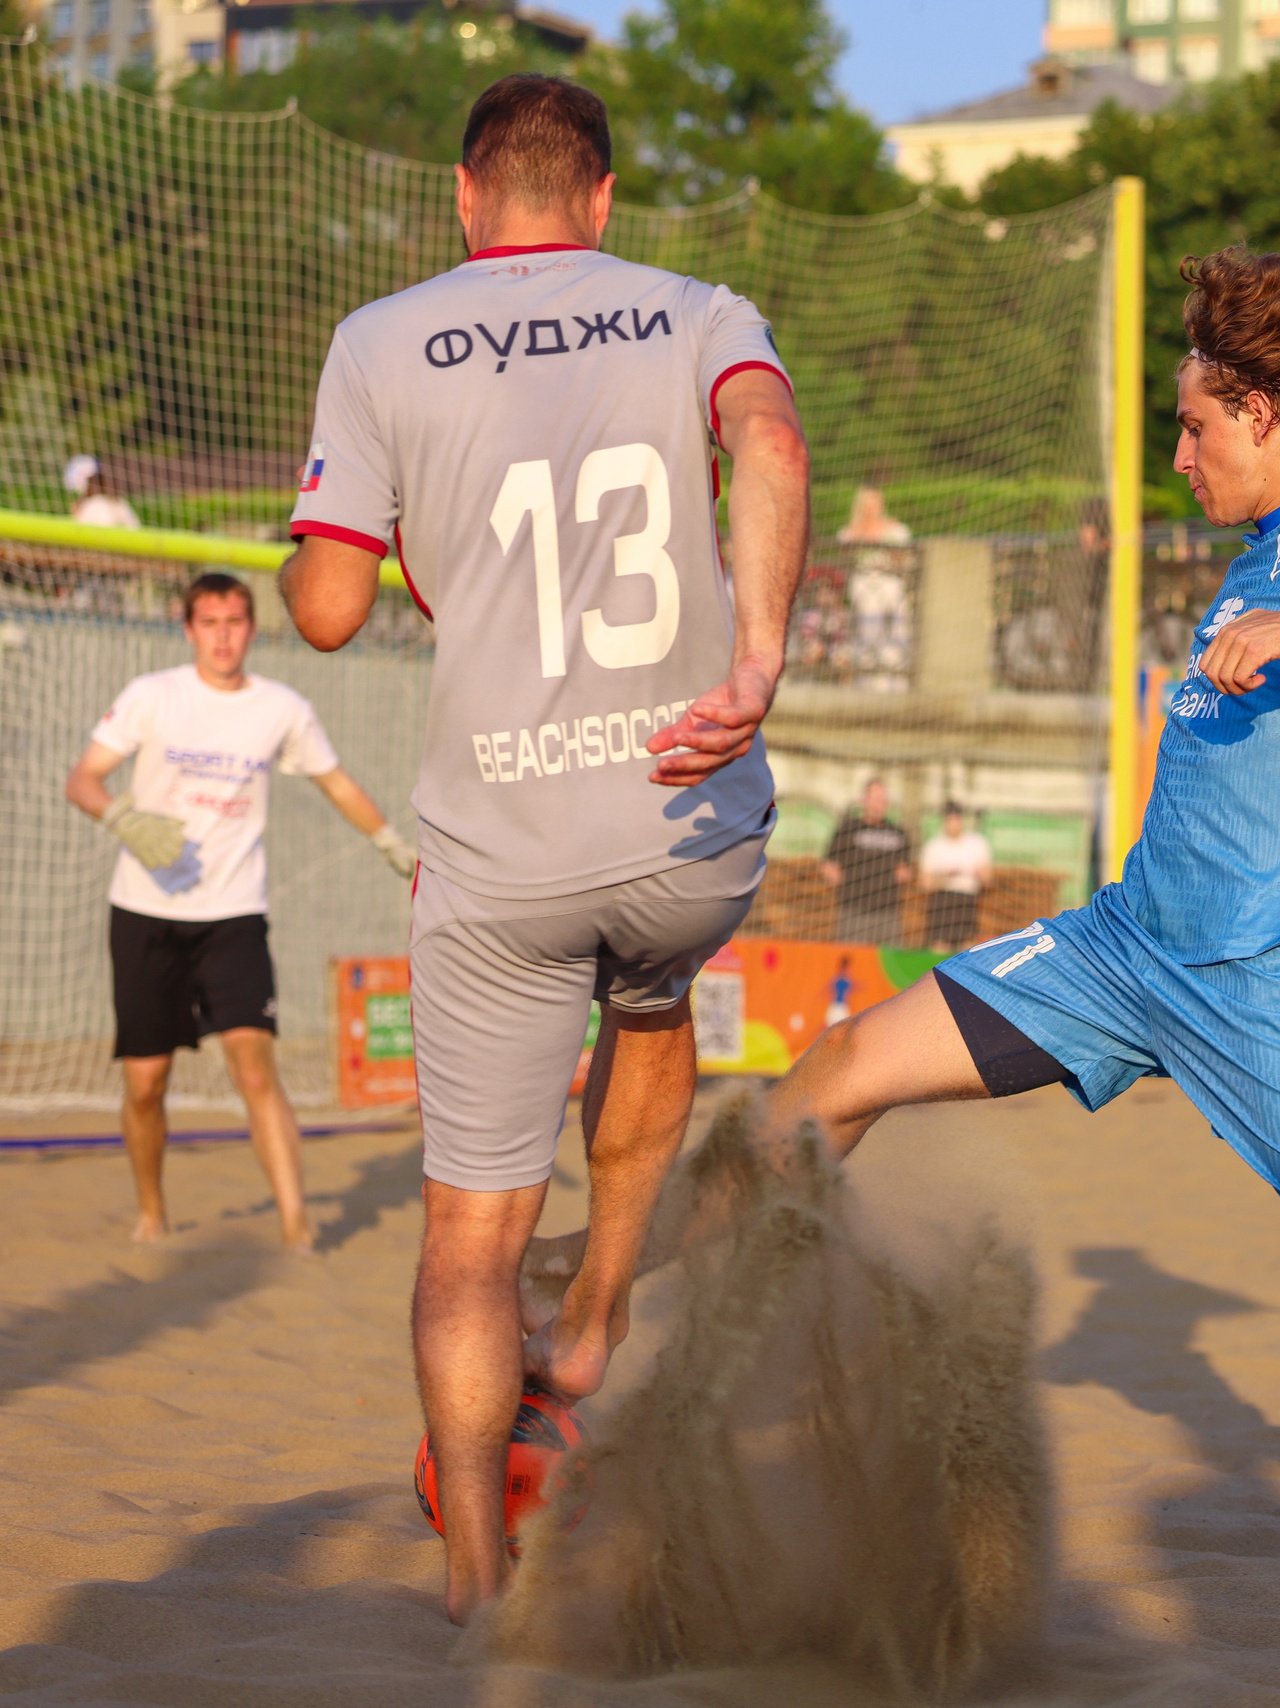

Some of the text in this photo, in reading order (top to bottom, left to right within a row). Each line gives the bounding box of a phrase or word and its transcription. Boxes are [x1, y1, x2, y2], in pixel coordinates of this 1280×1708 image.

[424, 307, 673, 374] ФУДЖИ
[489, 442, 681, 679] 13
[471, 699, 698, 783] BEACHSOCC
